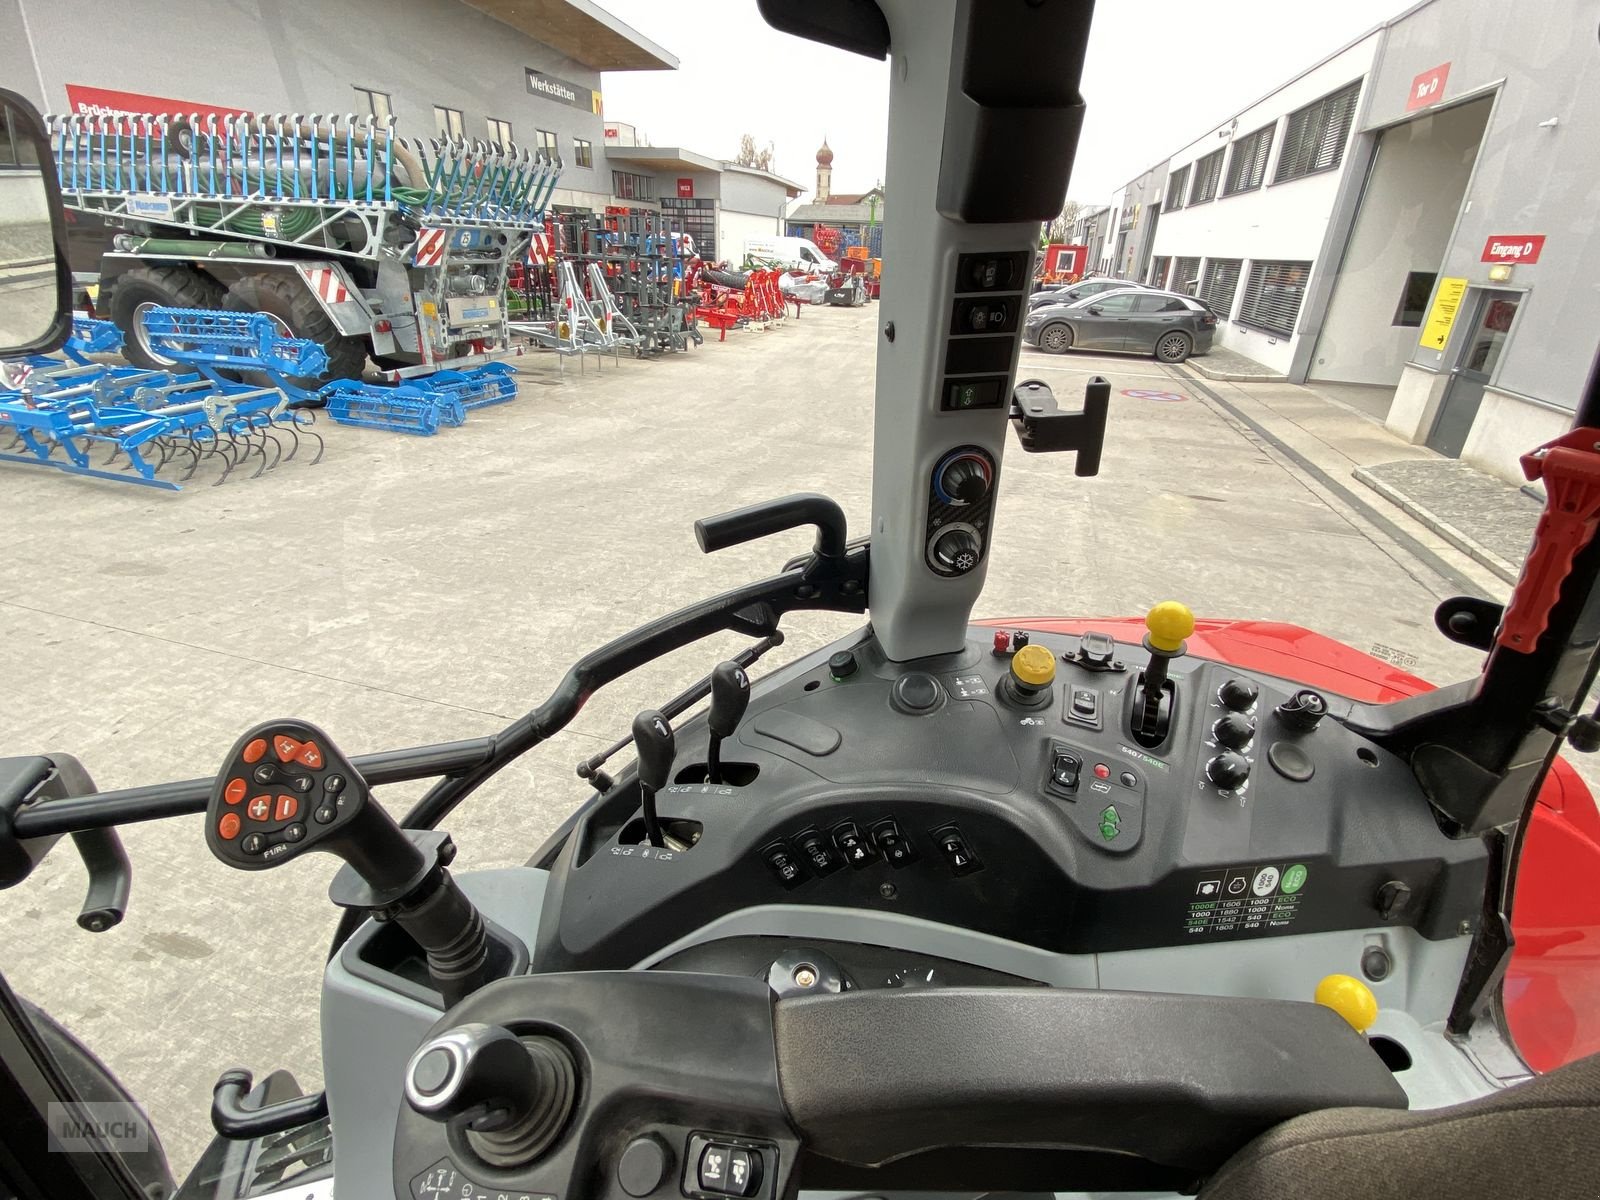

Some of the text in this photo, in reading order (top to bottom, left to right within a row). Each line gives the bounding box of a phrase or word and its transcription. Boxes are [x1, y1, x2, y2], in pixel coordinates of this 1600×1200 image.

[529, 74, 576, 102] Werkstätten
[1416, 77, 1439, 99] Tor D
[1490, 242, 1533, 258] Eingang D
[735, 669, 748, 689] 2
[654, 719, 668, 736] 1
[1248, 906, 1267, 914] 1000
[1250, 898, 1270, 906] 1000
[1247, 914, 1262, 922] 540
[1188, 926, 1204, 934] 540
[1244, 921, 1260, 929] 540
